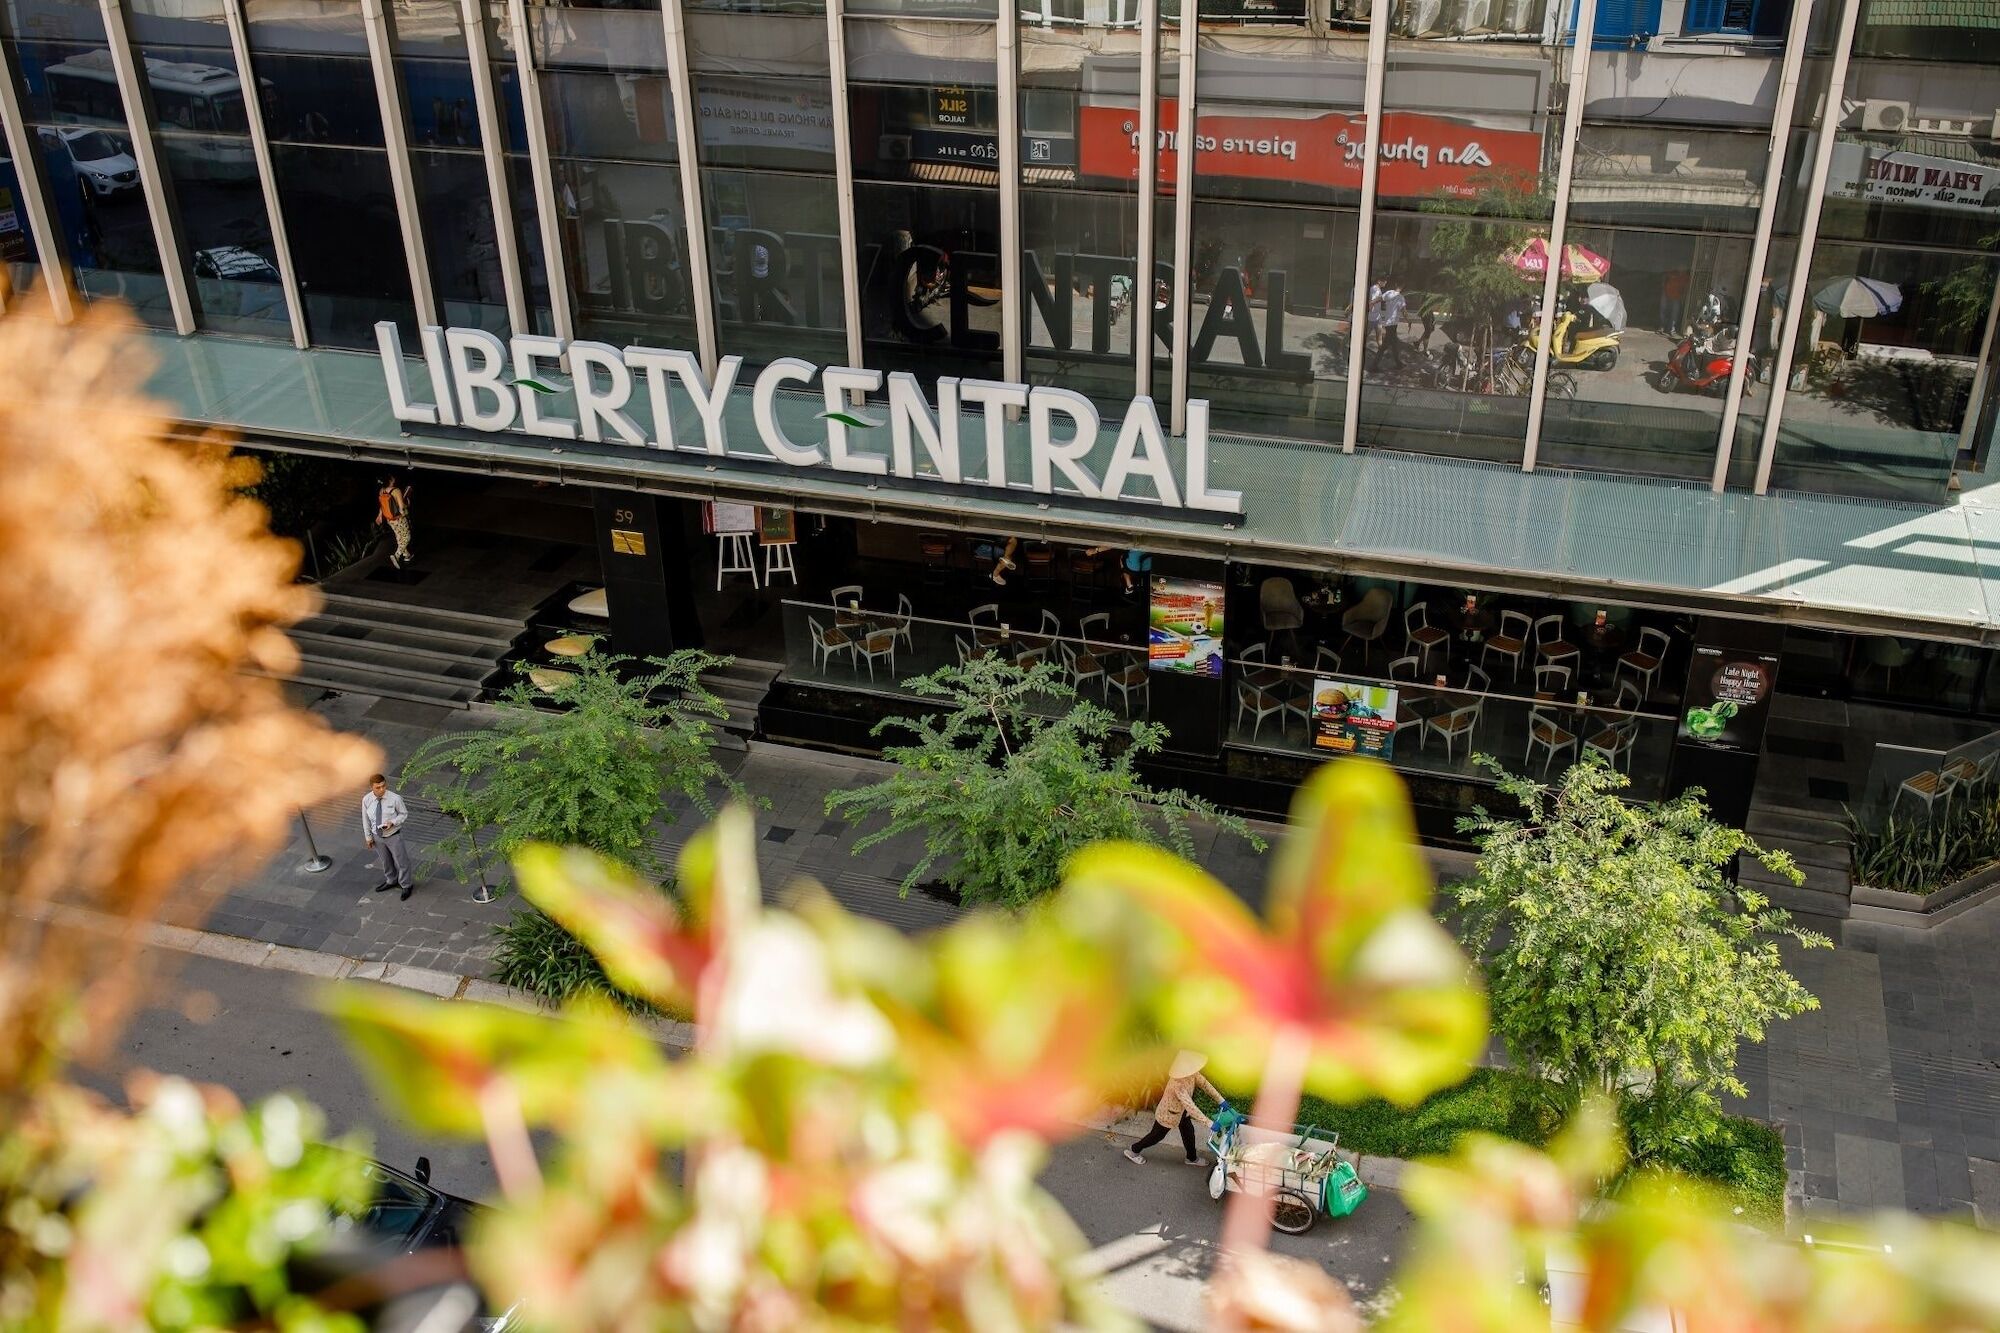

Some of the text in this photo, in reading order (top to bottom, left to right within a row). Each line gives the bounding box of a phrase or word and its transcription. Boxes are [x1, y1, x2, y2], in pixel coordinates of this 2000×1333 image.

[374, 321, 1243, 513] LIBERTY CENTRAL
[614, 509, 634, 525] 59
[1725, 667, 1759, 679] Late Night
[1720, 676, 1761, 688] Happy Hour
